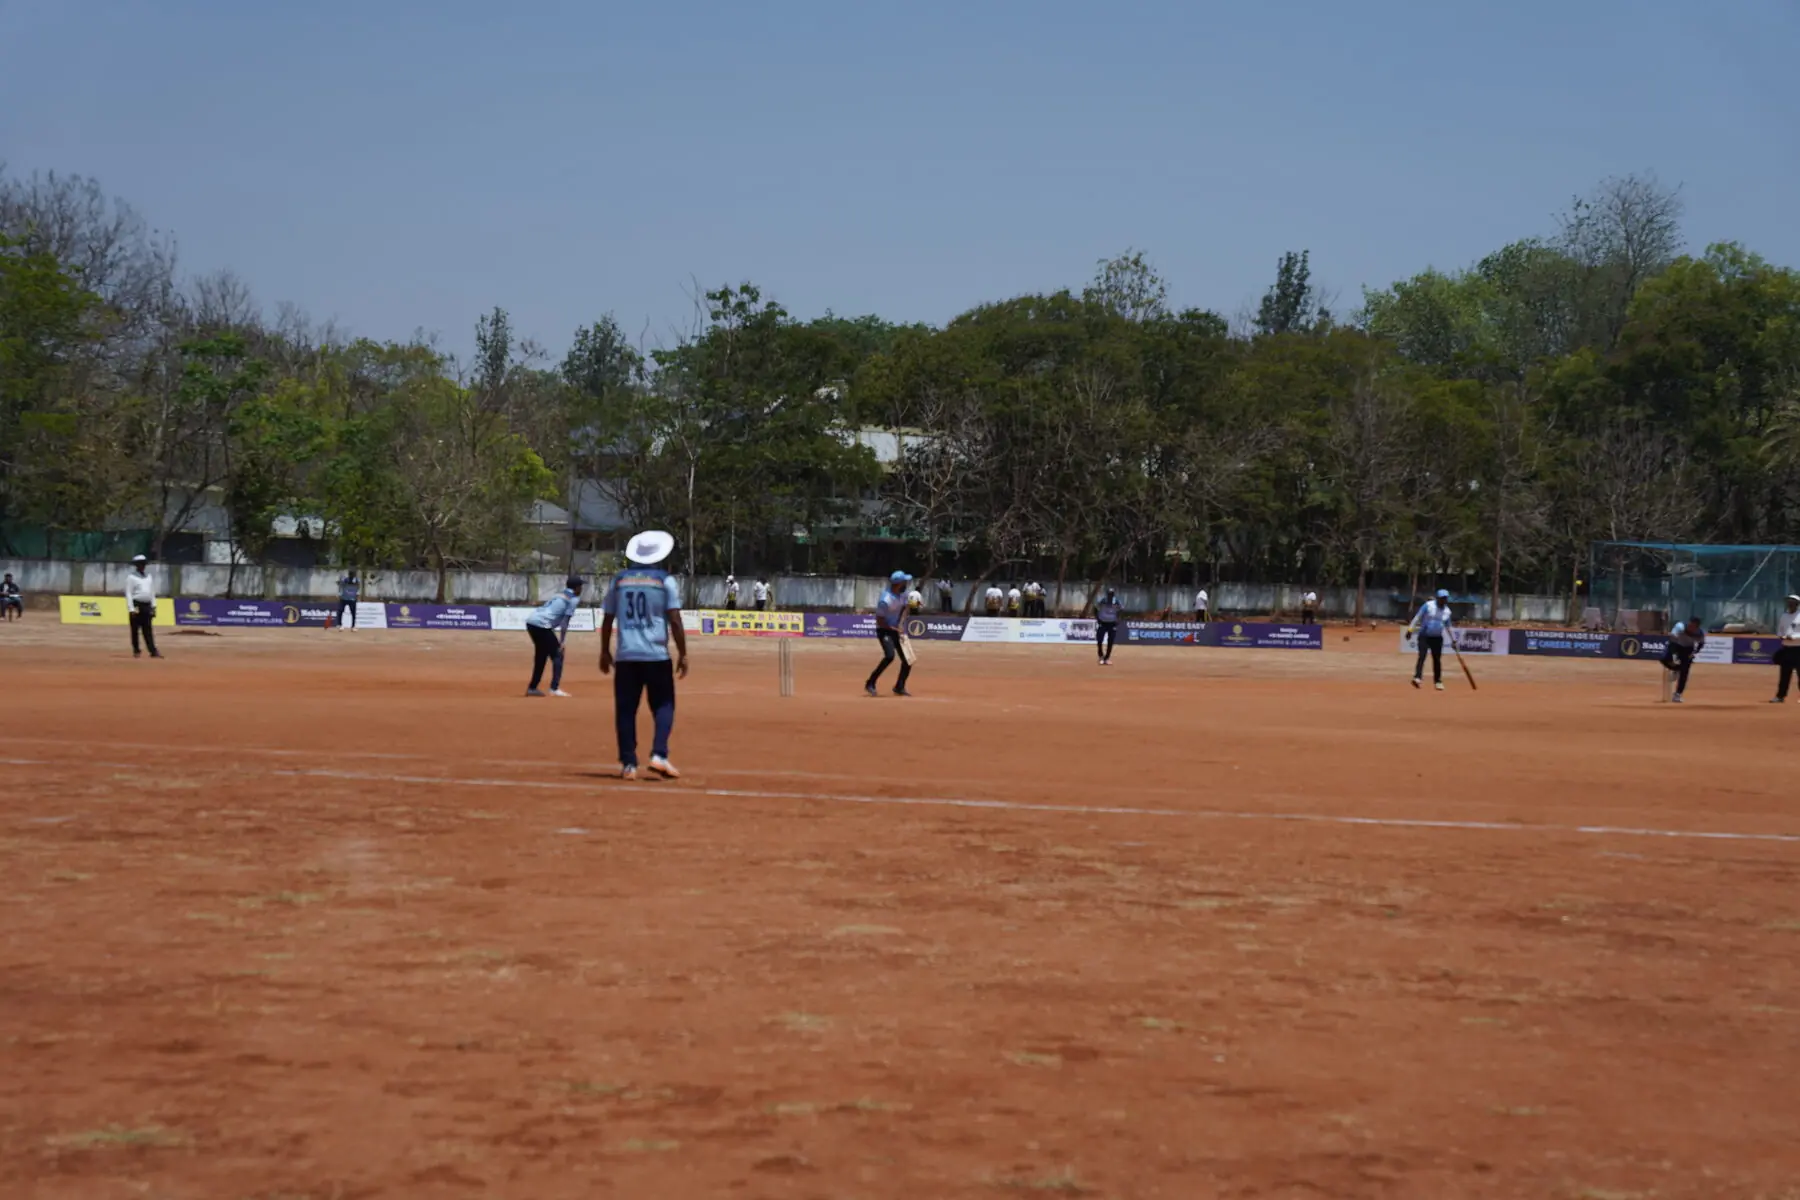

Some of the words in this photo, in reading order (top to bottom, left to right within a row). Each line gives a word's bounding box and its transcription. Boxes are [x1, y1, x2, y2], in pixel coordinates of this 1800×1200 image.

[625, 591, 647, 620] 30
[1126, 621, 1164, 629] LEARNING
[1139, 631, 1171, 639] CAREER
[1525, 631, 1565, 639] LEARNING
[1565, 632, 1589, 640] MADE
[1589, 633, 1610, 641] EASY
[1538, 640, 1572, 649] CAREER
[1573, 641, 1601, 650] POINT
